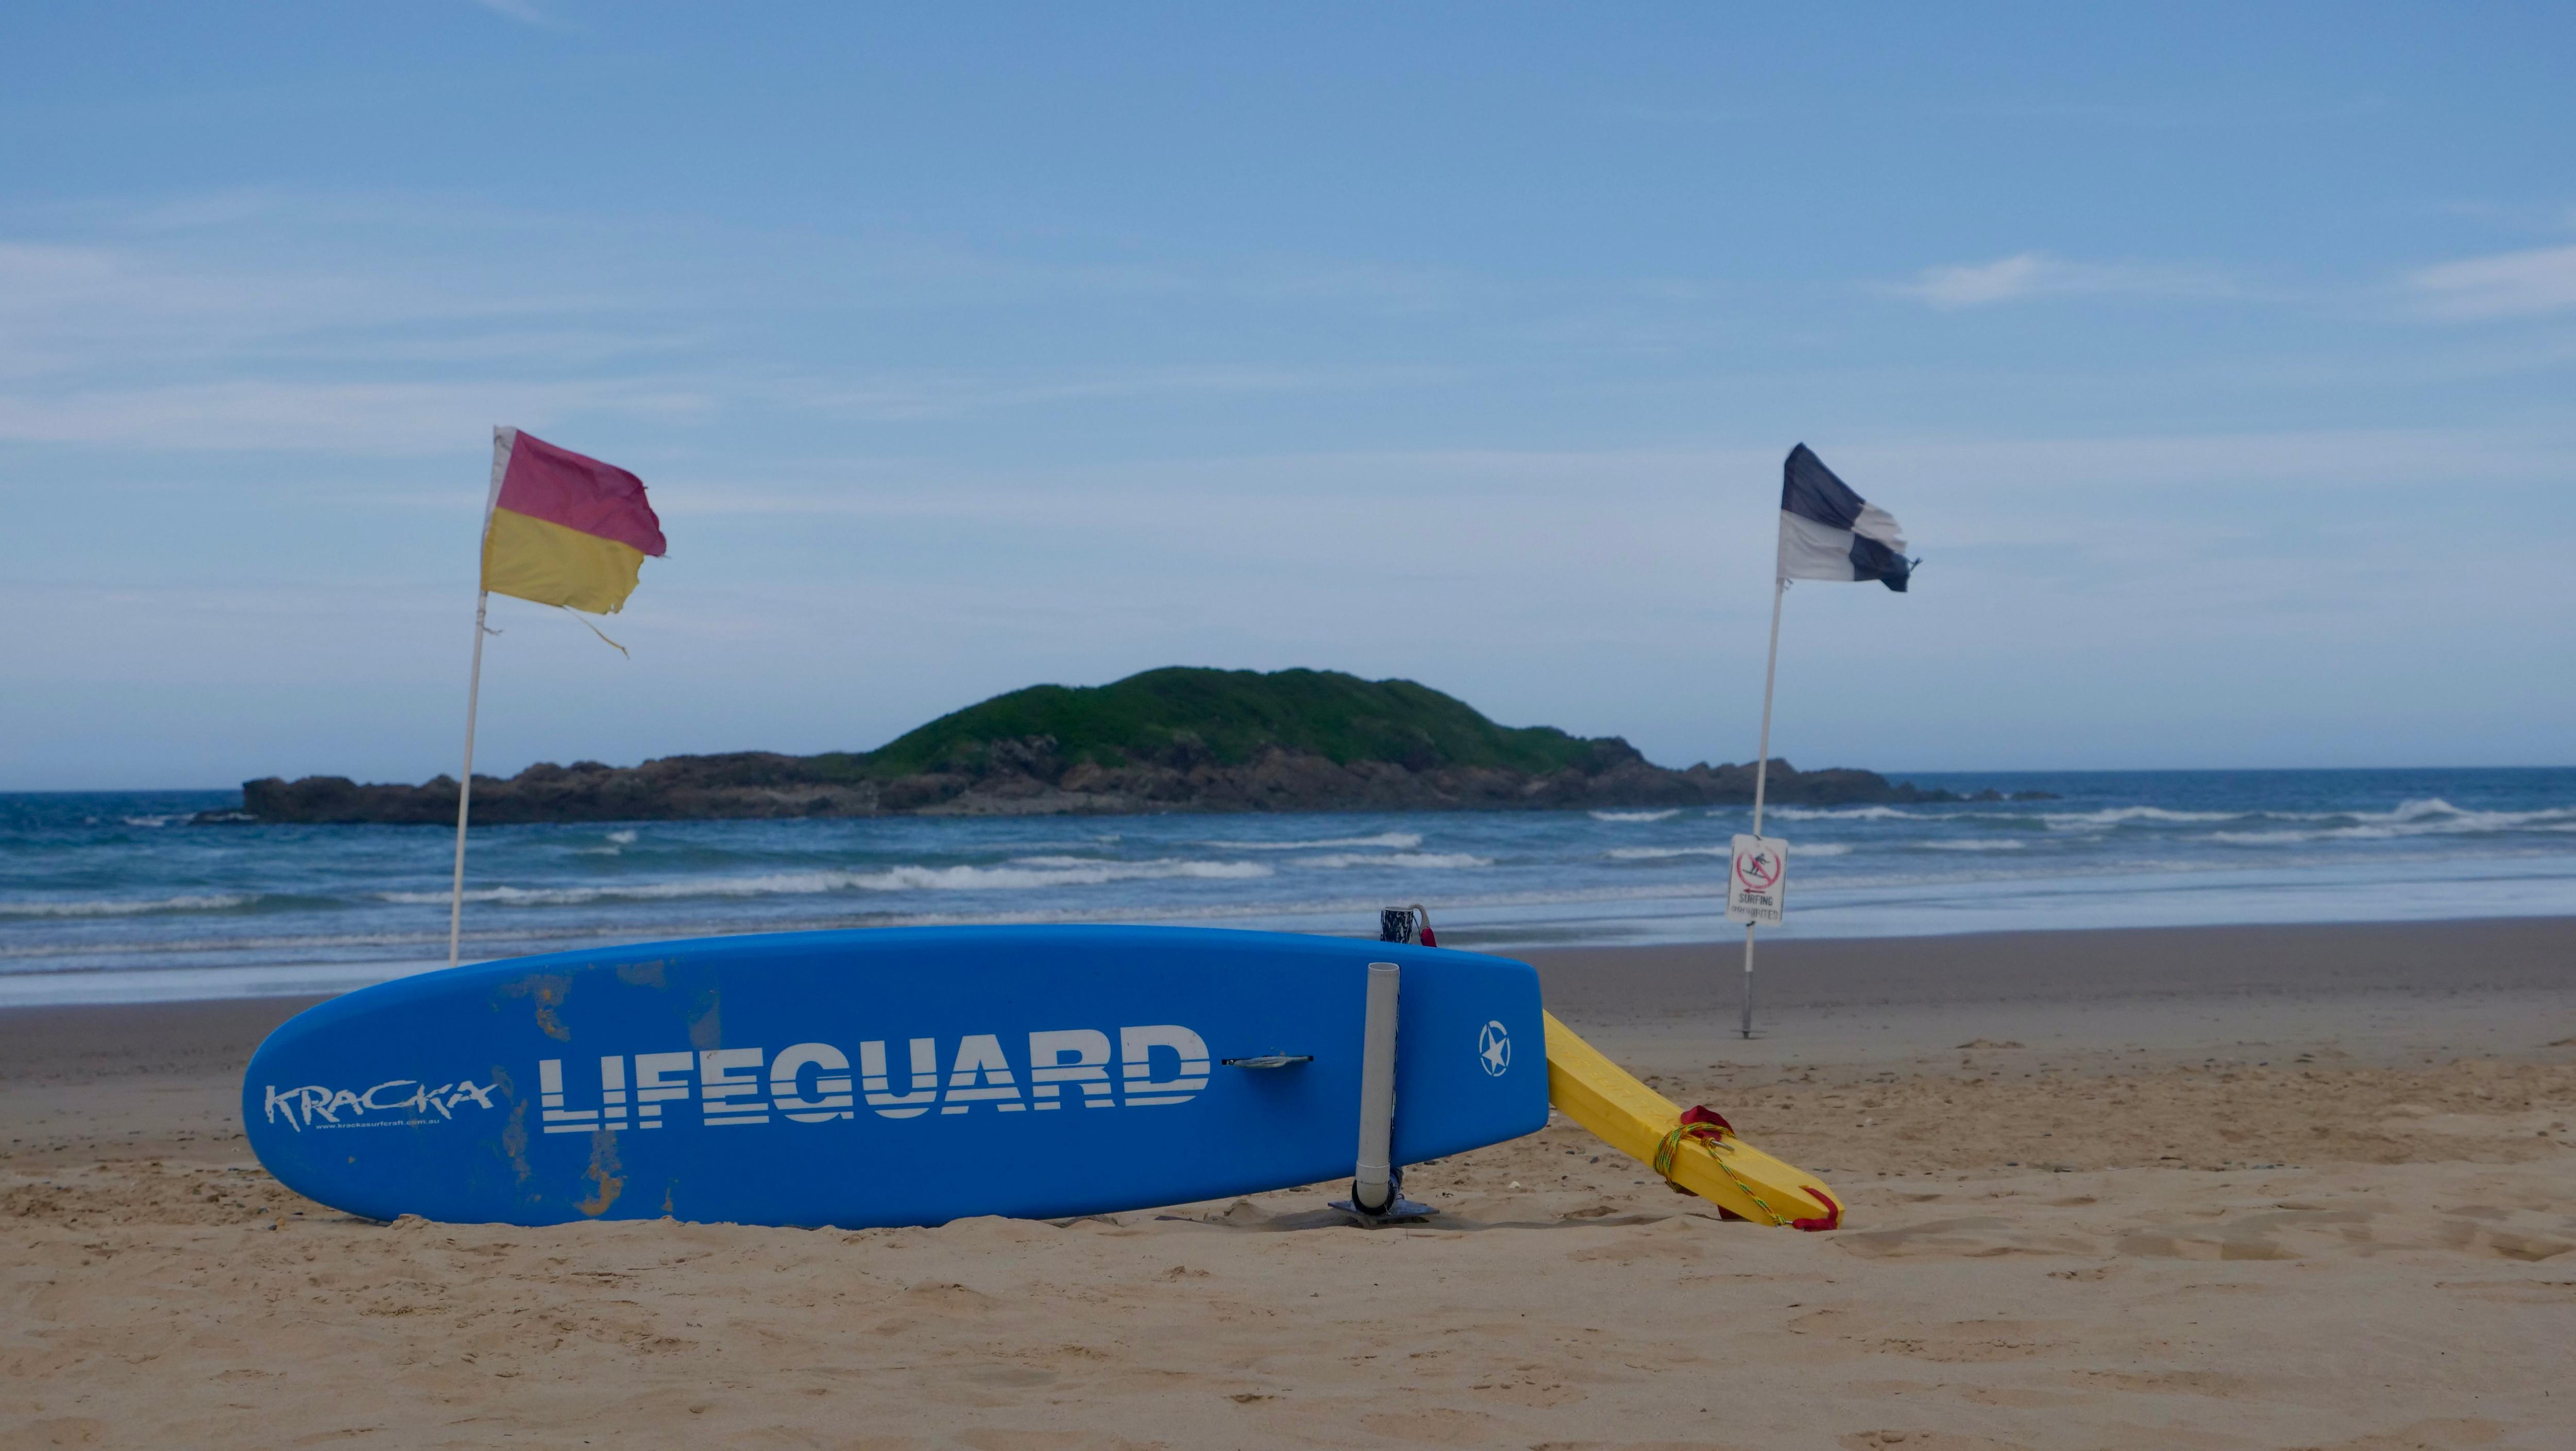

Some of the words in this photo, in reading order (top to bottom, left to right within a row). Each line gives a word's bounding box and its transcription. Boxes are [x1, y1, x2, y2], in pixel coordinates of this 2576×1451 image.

[1739, 893, 1773, 906] SURFING
[539, 1024, 1211, 1133] LIFEGUARD
[265, 1080, 498, 1132] KRACKA
[316, 1119, 440, 1129] www.krackasurfcraft.com.au
